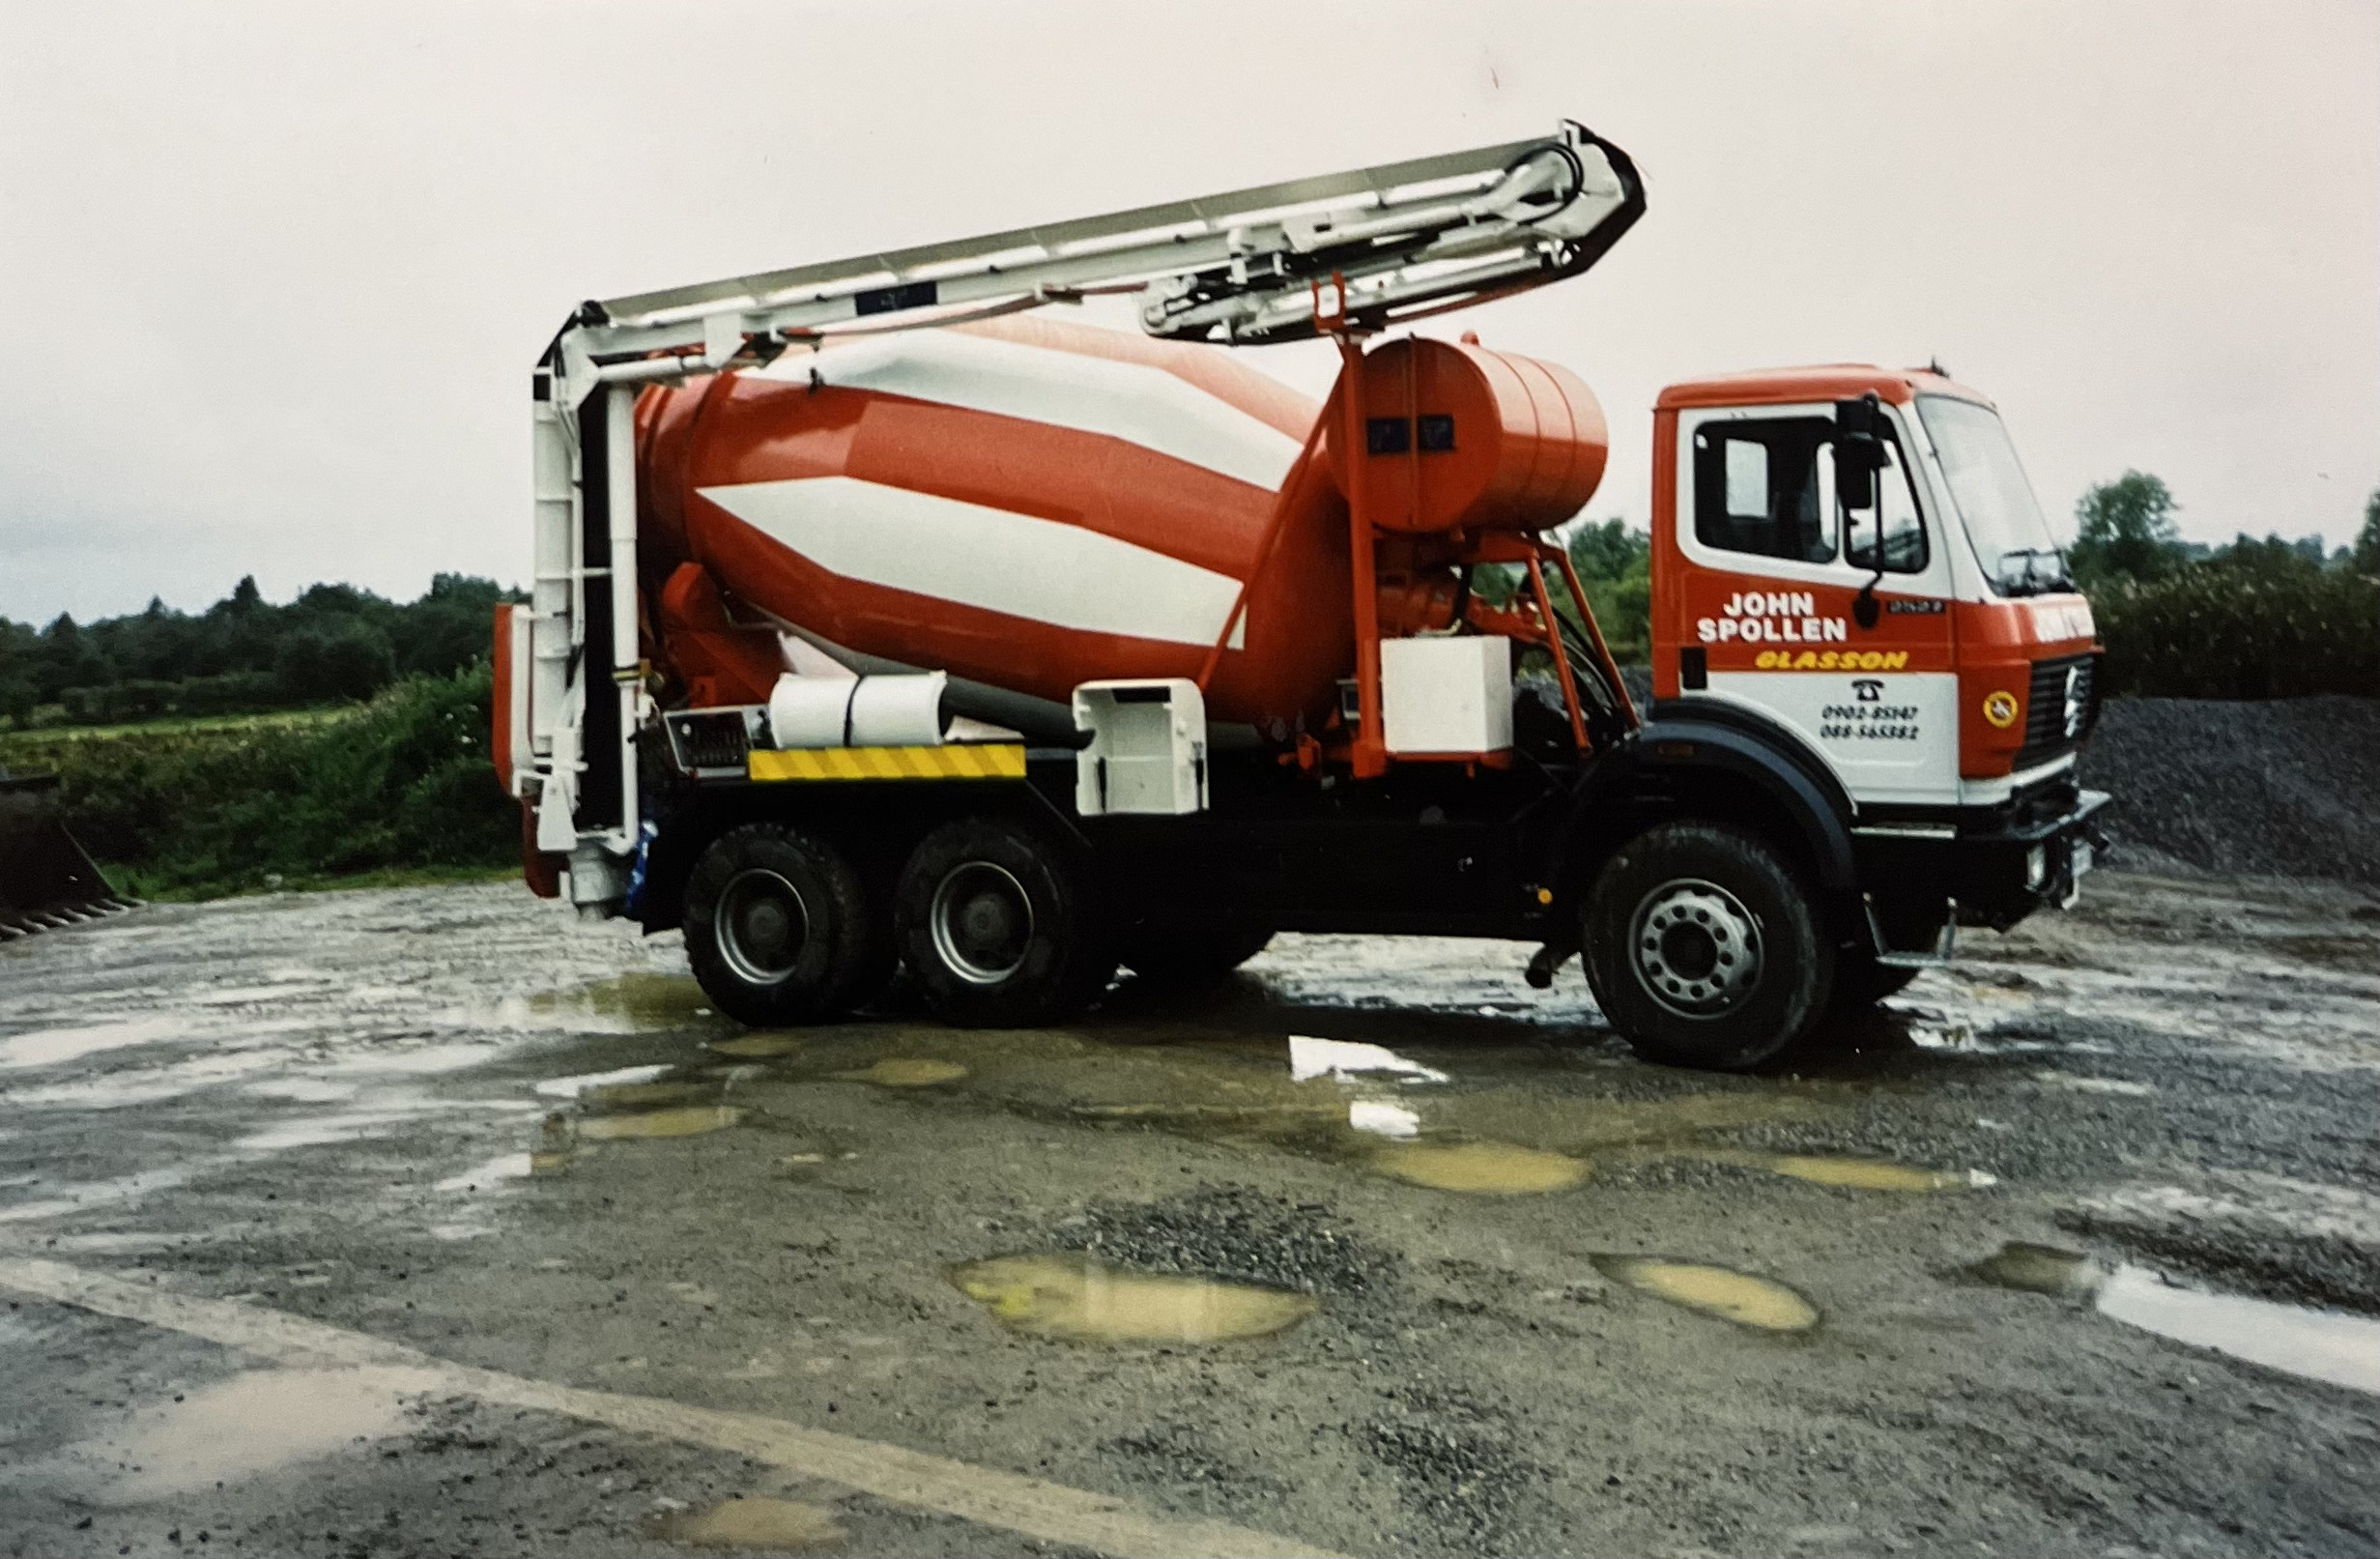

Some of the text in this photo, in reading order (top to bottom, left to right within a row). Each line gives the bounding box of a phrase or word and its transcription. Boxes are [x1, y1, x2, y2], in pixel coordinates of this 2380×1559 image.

[1723, 592, 1815, 617] JOHN
[1697, 617, 1848, 642] SPOLLEN
[1755, 650, 1909, 670] GLASSON
